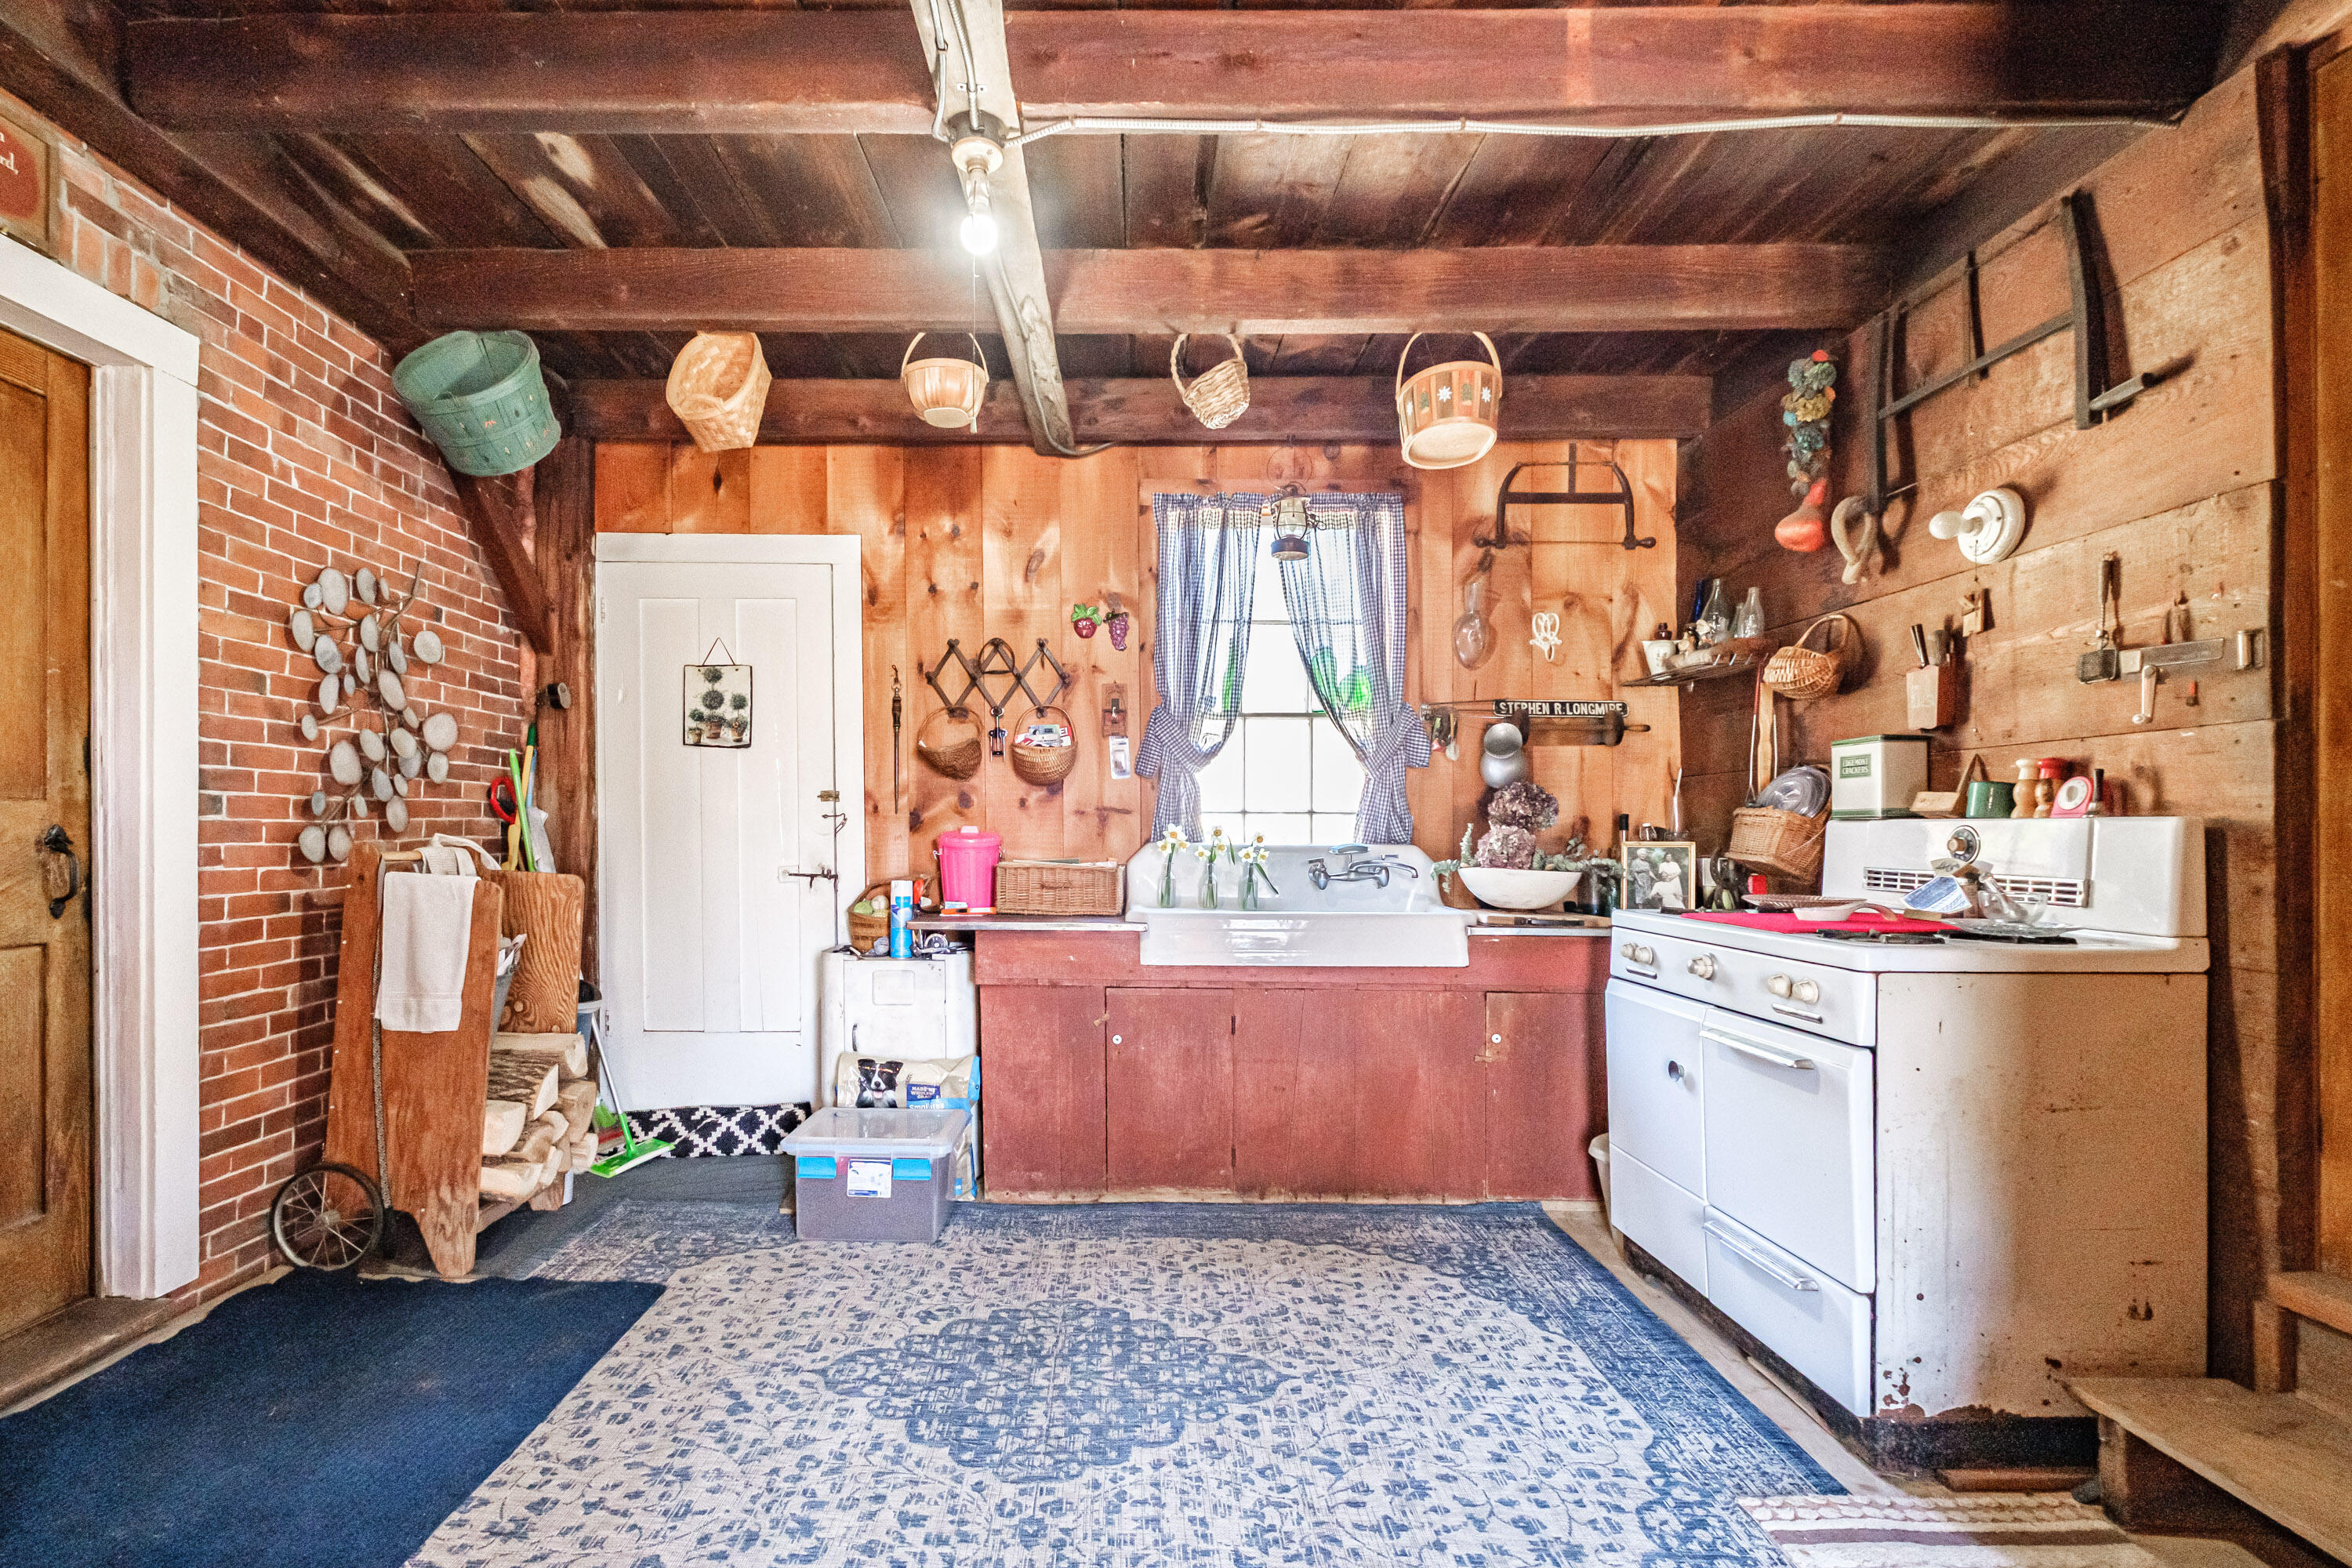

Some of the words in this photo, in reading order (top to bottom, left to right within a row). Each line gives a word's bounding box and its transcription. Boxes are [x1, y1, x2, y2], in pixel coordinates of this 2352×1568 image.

[1499, 702, 1550, 714] STEPHEN
[1842, 758, 1869, 768] EDGEMONT
[1842, 766, 1869, 775] CRACKERS
